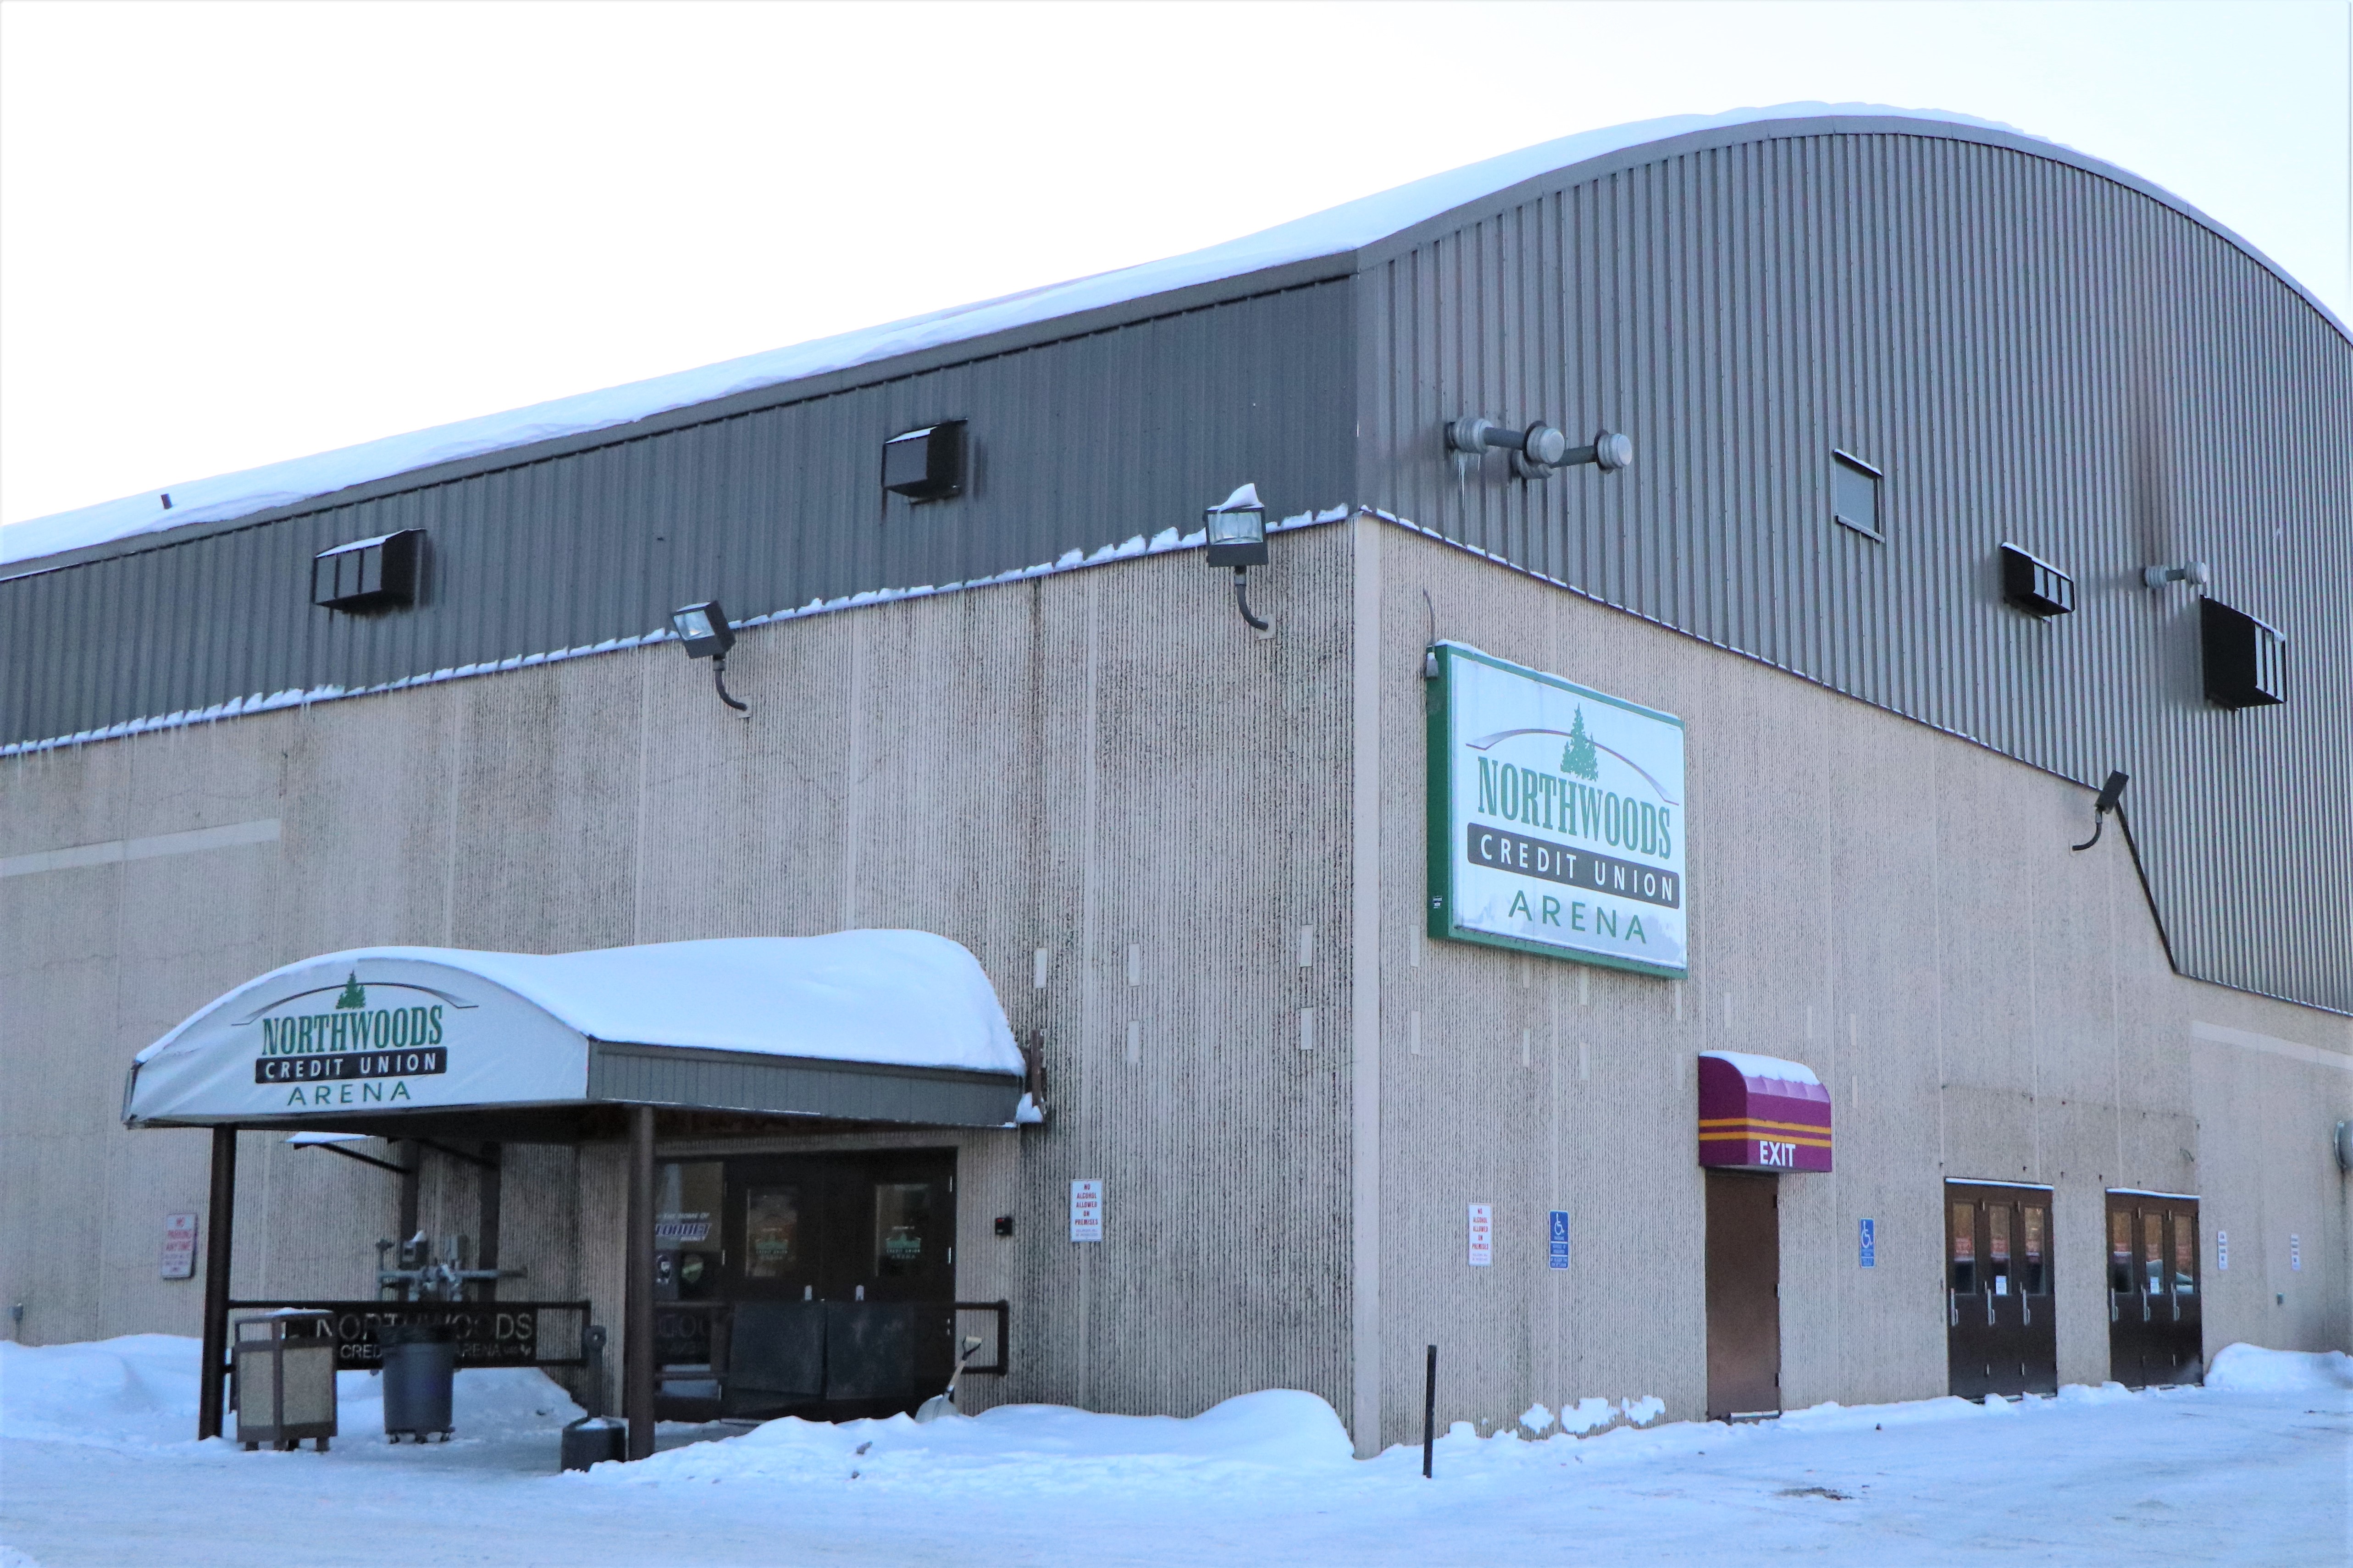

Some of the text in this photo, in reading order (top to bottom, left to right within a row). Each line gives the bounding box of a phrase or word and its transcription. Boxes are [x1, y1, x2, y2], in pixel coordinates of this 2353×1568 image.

[1478, 756, 1671, 860] NORTHWOODS
[1480, 834, 1673, 901] CREDIT UNION
[1508, 890, 1647, 944] ARENA
[262, 1005, 443, 1055] NORTHWOODS
[265, 1053, 436, 1079] CREDIT UNION
[287, 1080, 411, 1106] ARENA
[1760, 1140, 1796, 1167] EXIT
[340, 1343, 383, 1359] CRED
